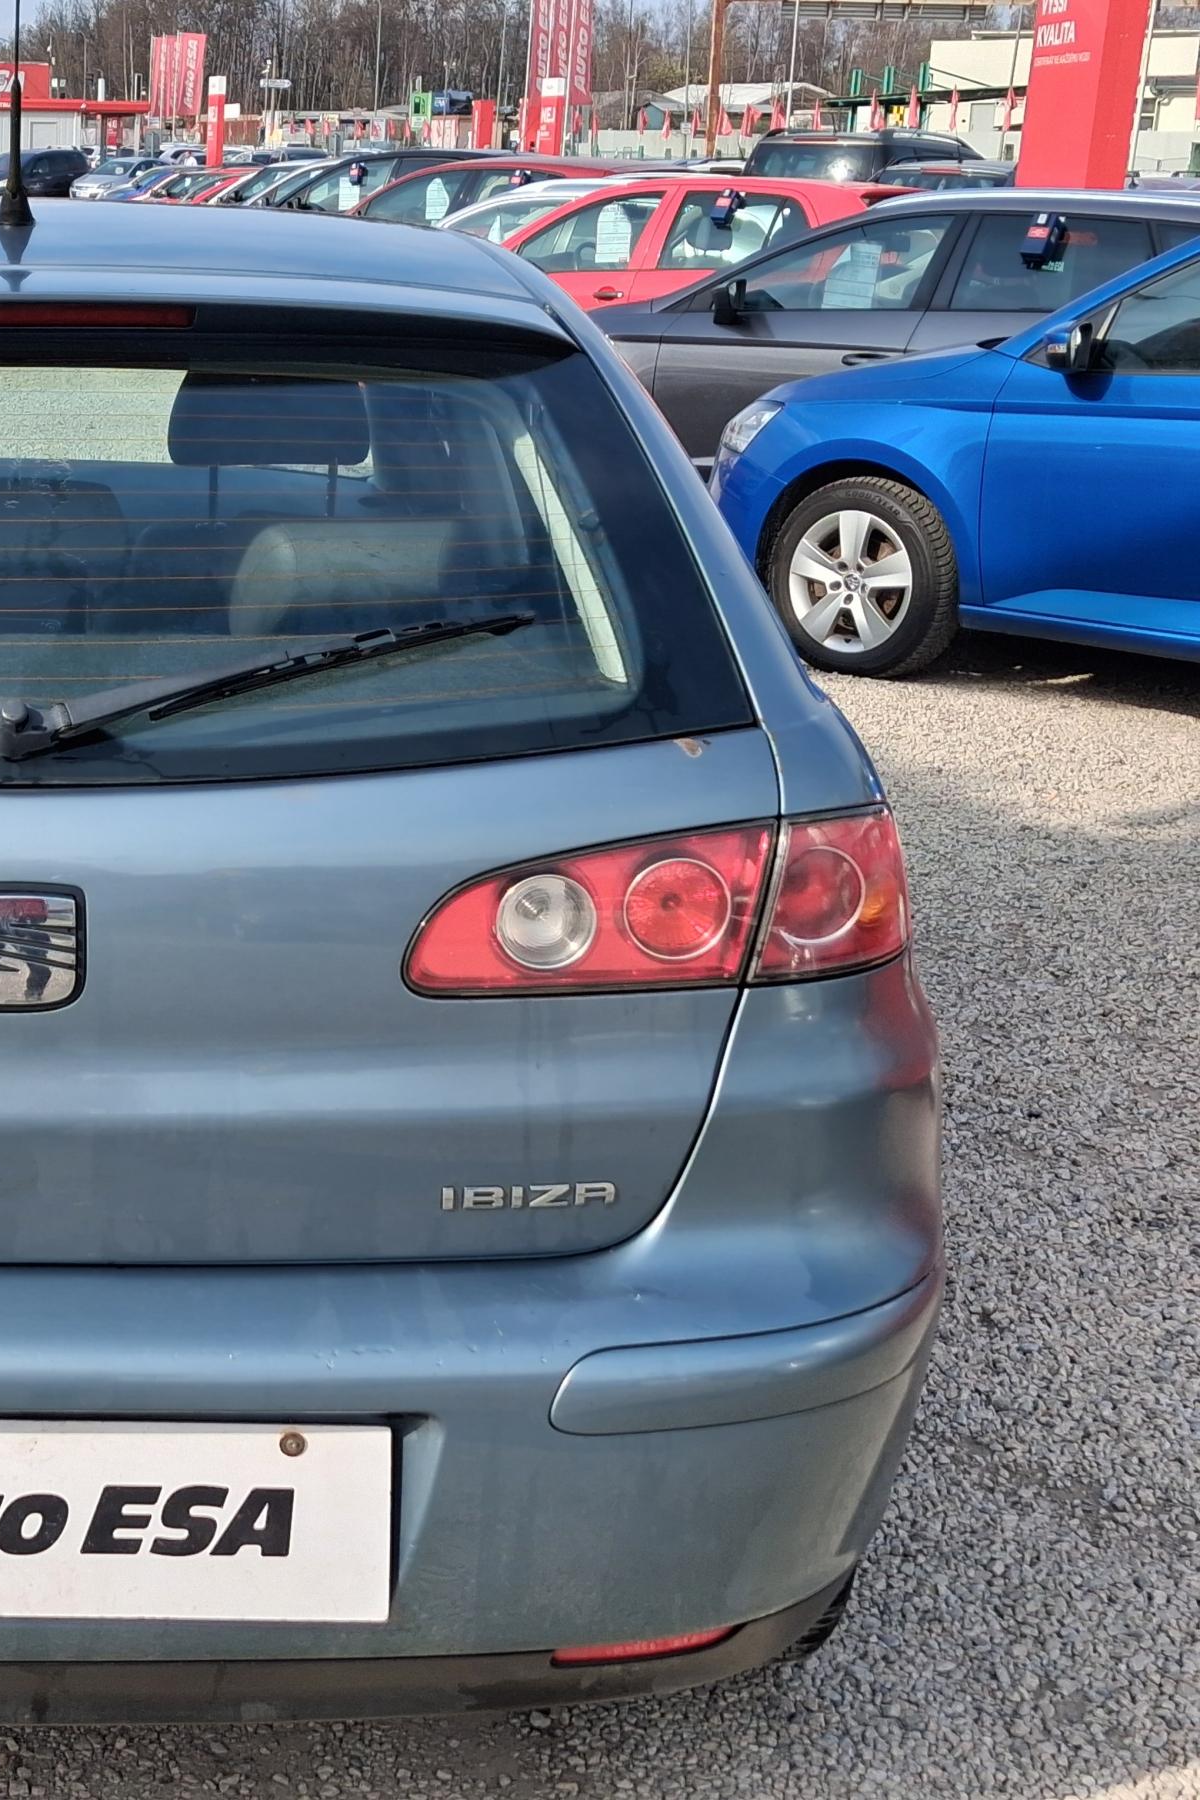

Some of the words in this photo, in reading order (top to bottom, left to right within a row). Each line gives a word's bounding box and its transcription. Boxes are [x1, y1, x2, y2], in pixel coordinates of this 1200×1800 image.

[1036, 20, 1075, 48] KVALITA
[844, 489, 901, 517] GOODYEAR
[441, 1182, 616, 1210] IBIZA
[79, 1484, 295, 1557] ESA
